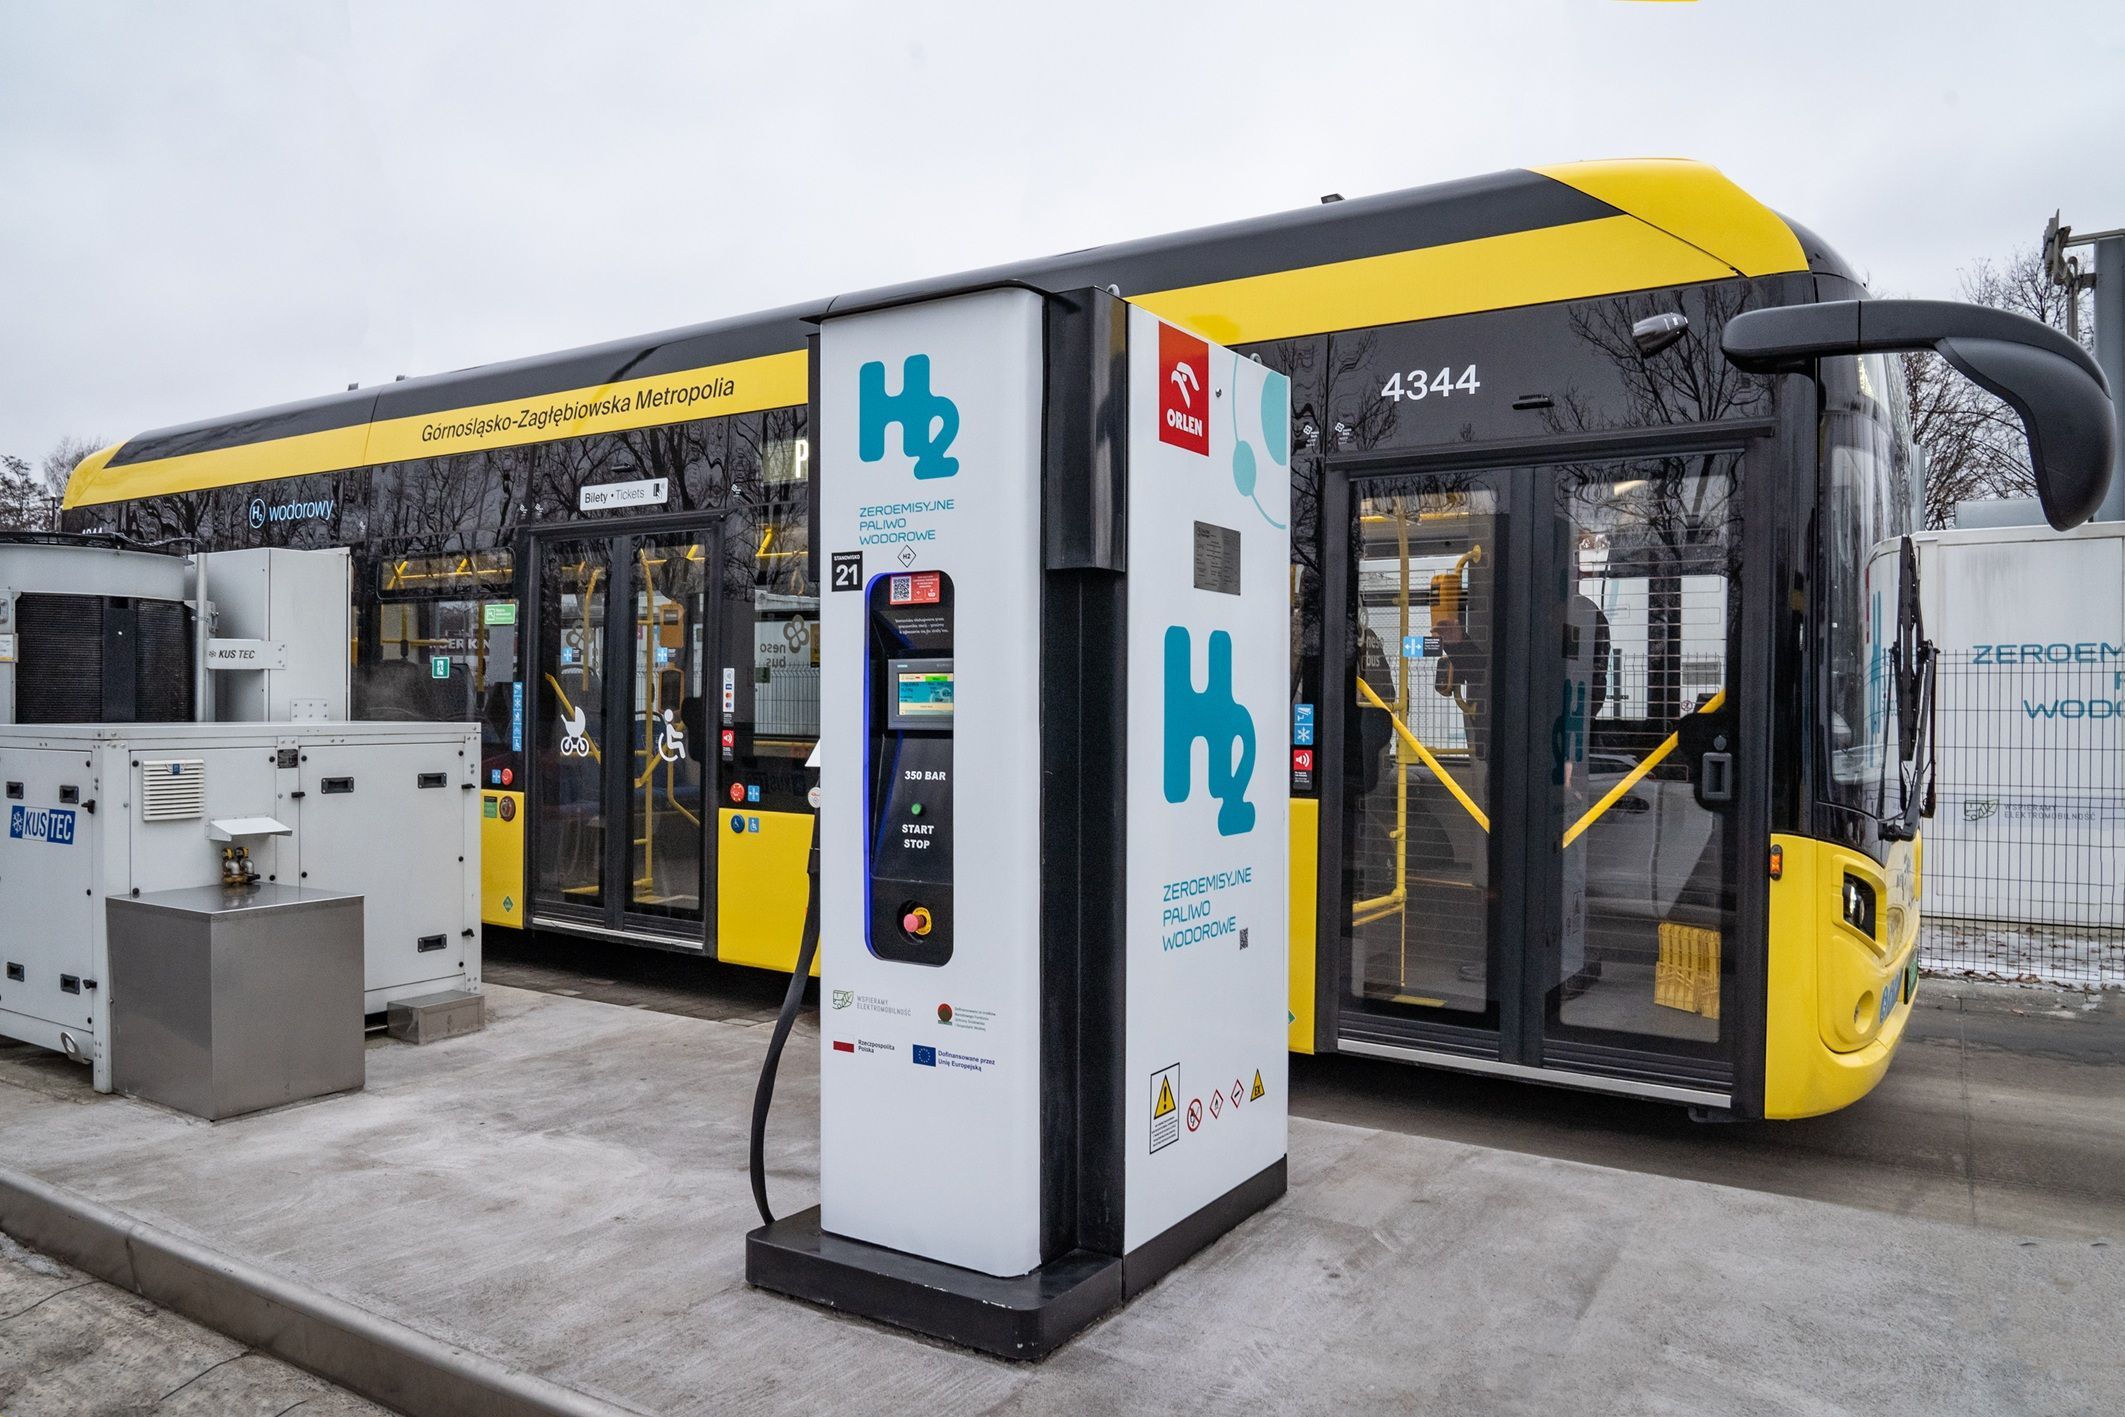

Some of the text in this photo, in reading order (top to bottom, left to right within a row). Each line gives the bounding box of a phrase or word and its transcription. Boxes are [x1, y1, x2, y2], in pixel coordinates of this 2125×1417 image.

[1381, 364, 1480, 402] 4344
[421, 377, 735, 443] Górnośląsko-Zagłębiowska Metropolia
[859, 353, 960, 480] H2
[1167, 408, 1203, 438] ORLEN
[585, 489, 645, 504] Bilety Tickets
[268, 500, 334, 522] wodorowy
[859, 499, 955, 518] ZEROEMISYJNE
[859, 518, 906, 532] PALIWO
[859, 529, 936, 546] WODOROWE
[835, 563, 858, 586] 21
[218, 649, 256, 659] KUS TEC
[1163, 625, 1256, 837] H2
[904, 771, 946, 781] 350 BAR
[901, 824, 935, 835] START
[904, 839, 931, 849] STOP
[1163, 867, 1252, 902] ZEROEMISYJNE
[1163, 900, 1211, 927] PALIWO
[1162, 916, 1237, 952] WODOROWE
[857, 995, 889, 1005] WSPIERAMY
[858, 1039, 895, 1051] Rzeczpospolita
[858, 1045, 875, 1053] Polska
[937, 1050, 996, 1065] Dofinansowane przez
[938, 1058, 982, 1073] Unię Europejską
